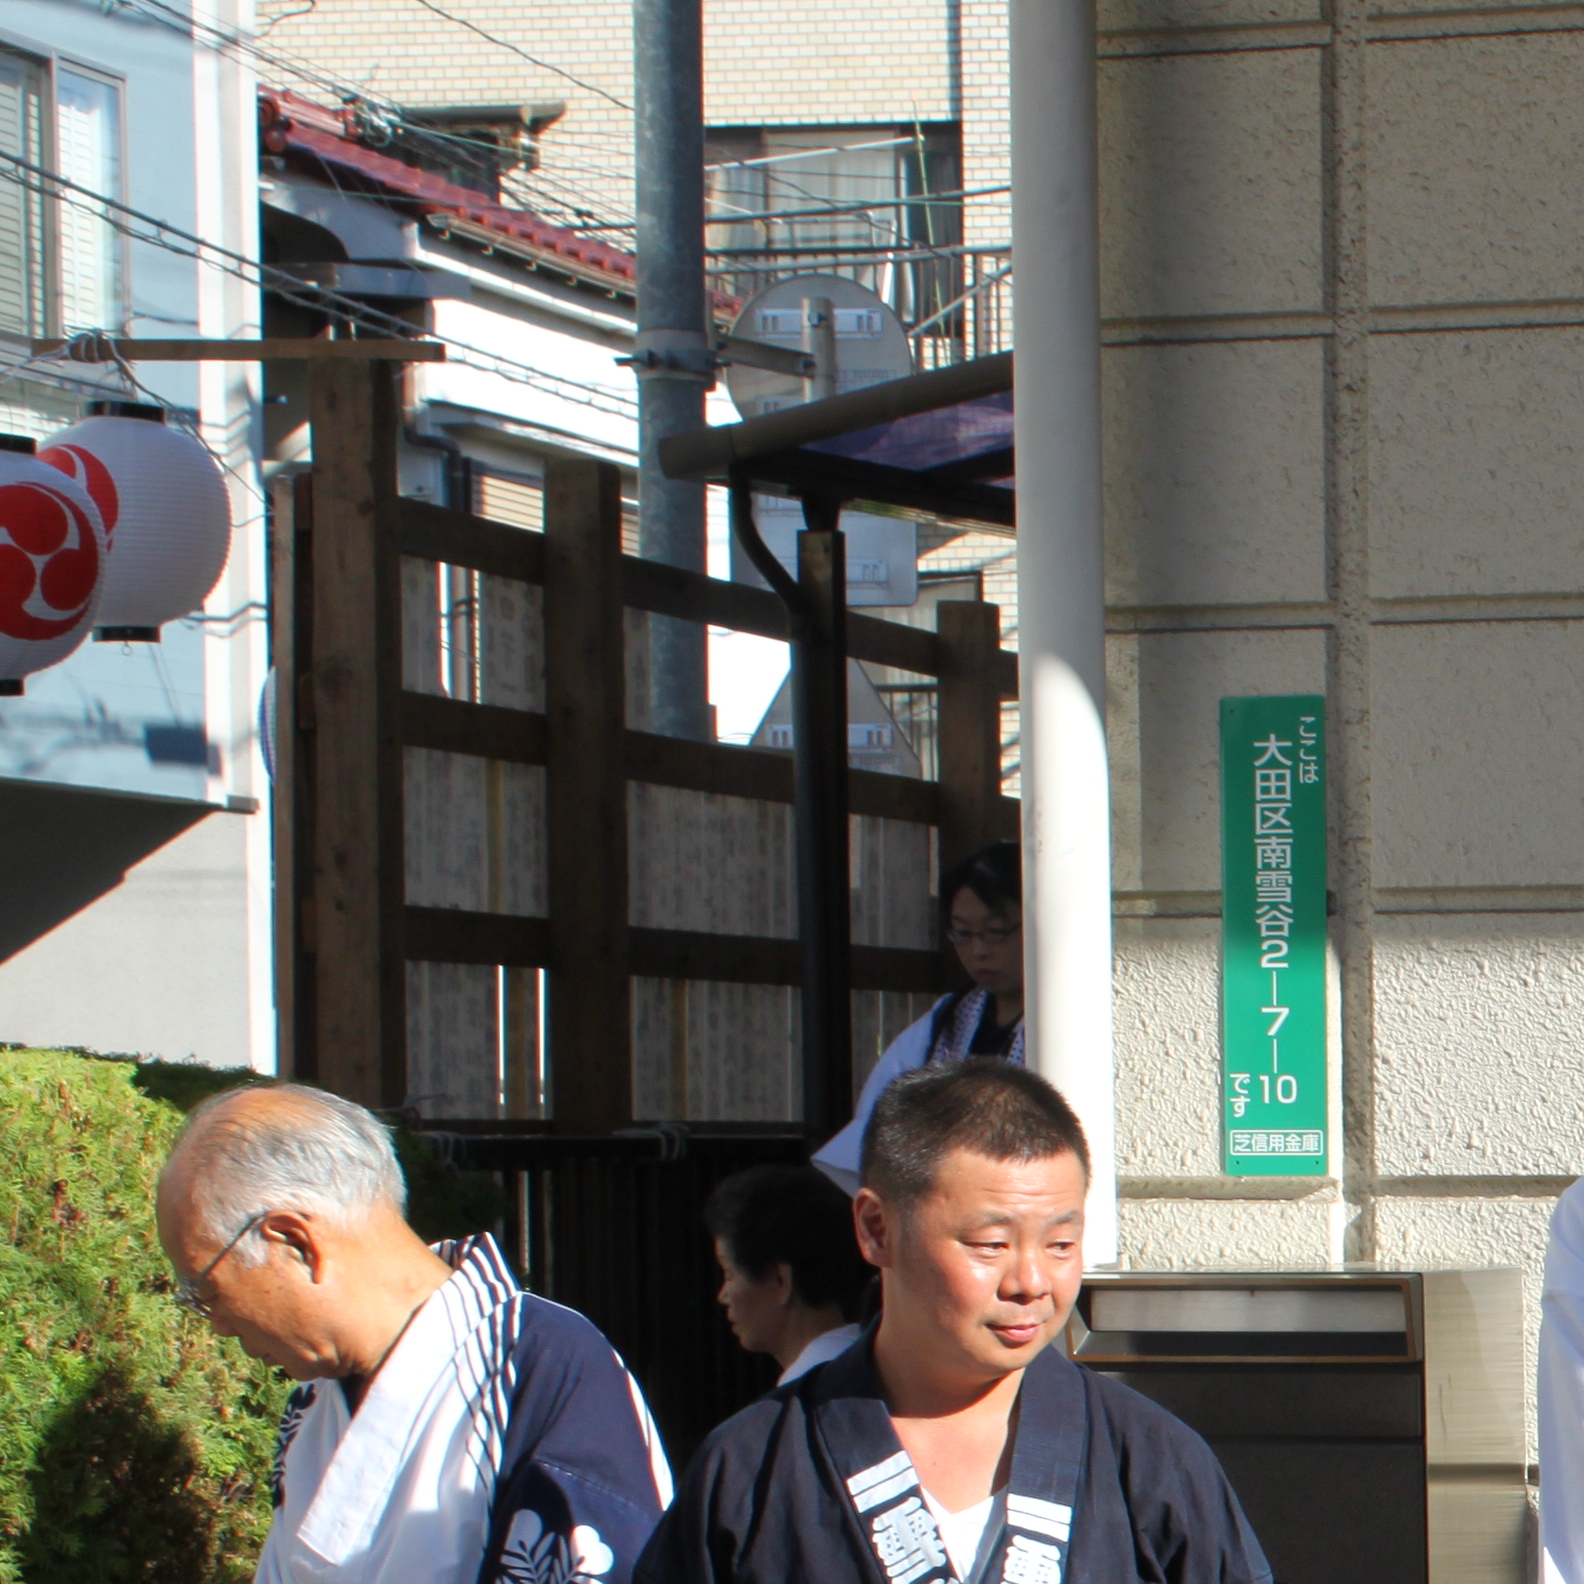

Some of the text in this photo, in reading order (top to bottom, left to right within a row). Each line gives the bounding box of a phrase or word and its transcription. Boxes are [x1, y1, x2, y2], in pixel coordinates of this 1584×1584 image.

[1299, 716, 1319, 784] ここは
[1229, 1072, 1251, 1118] です
[1233, 1132, 1321, 1154] 芝信用金庫
